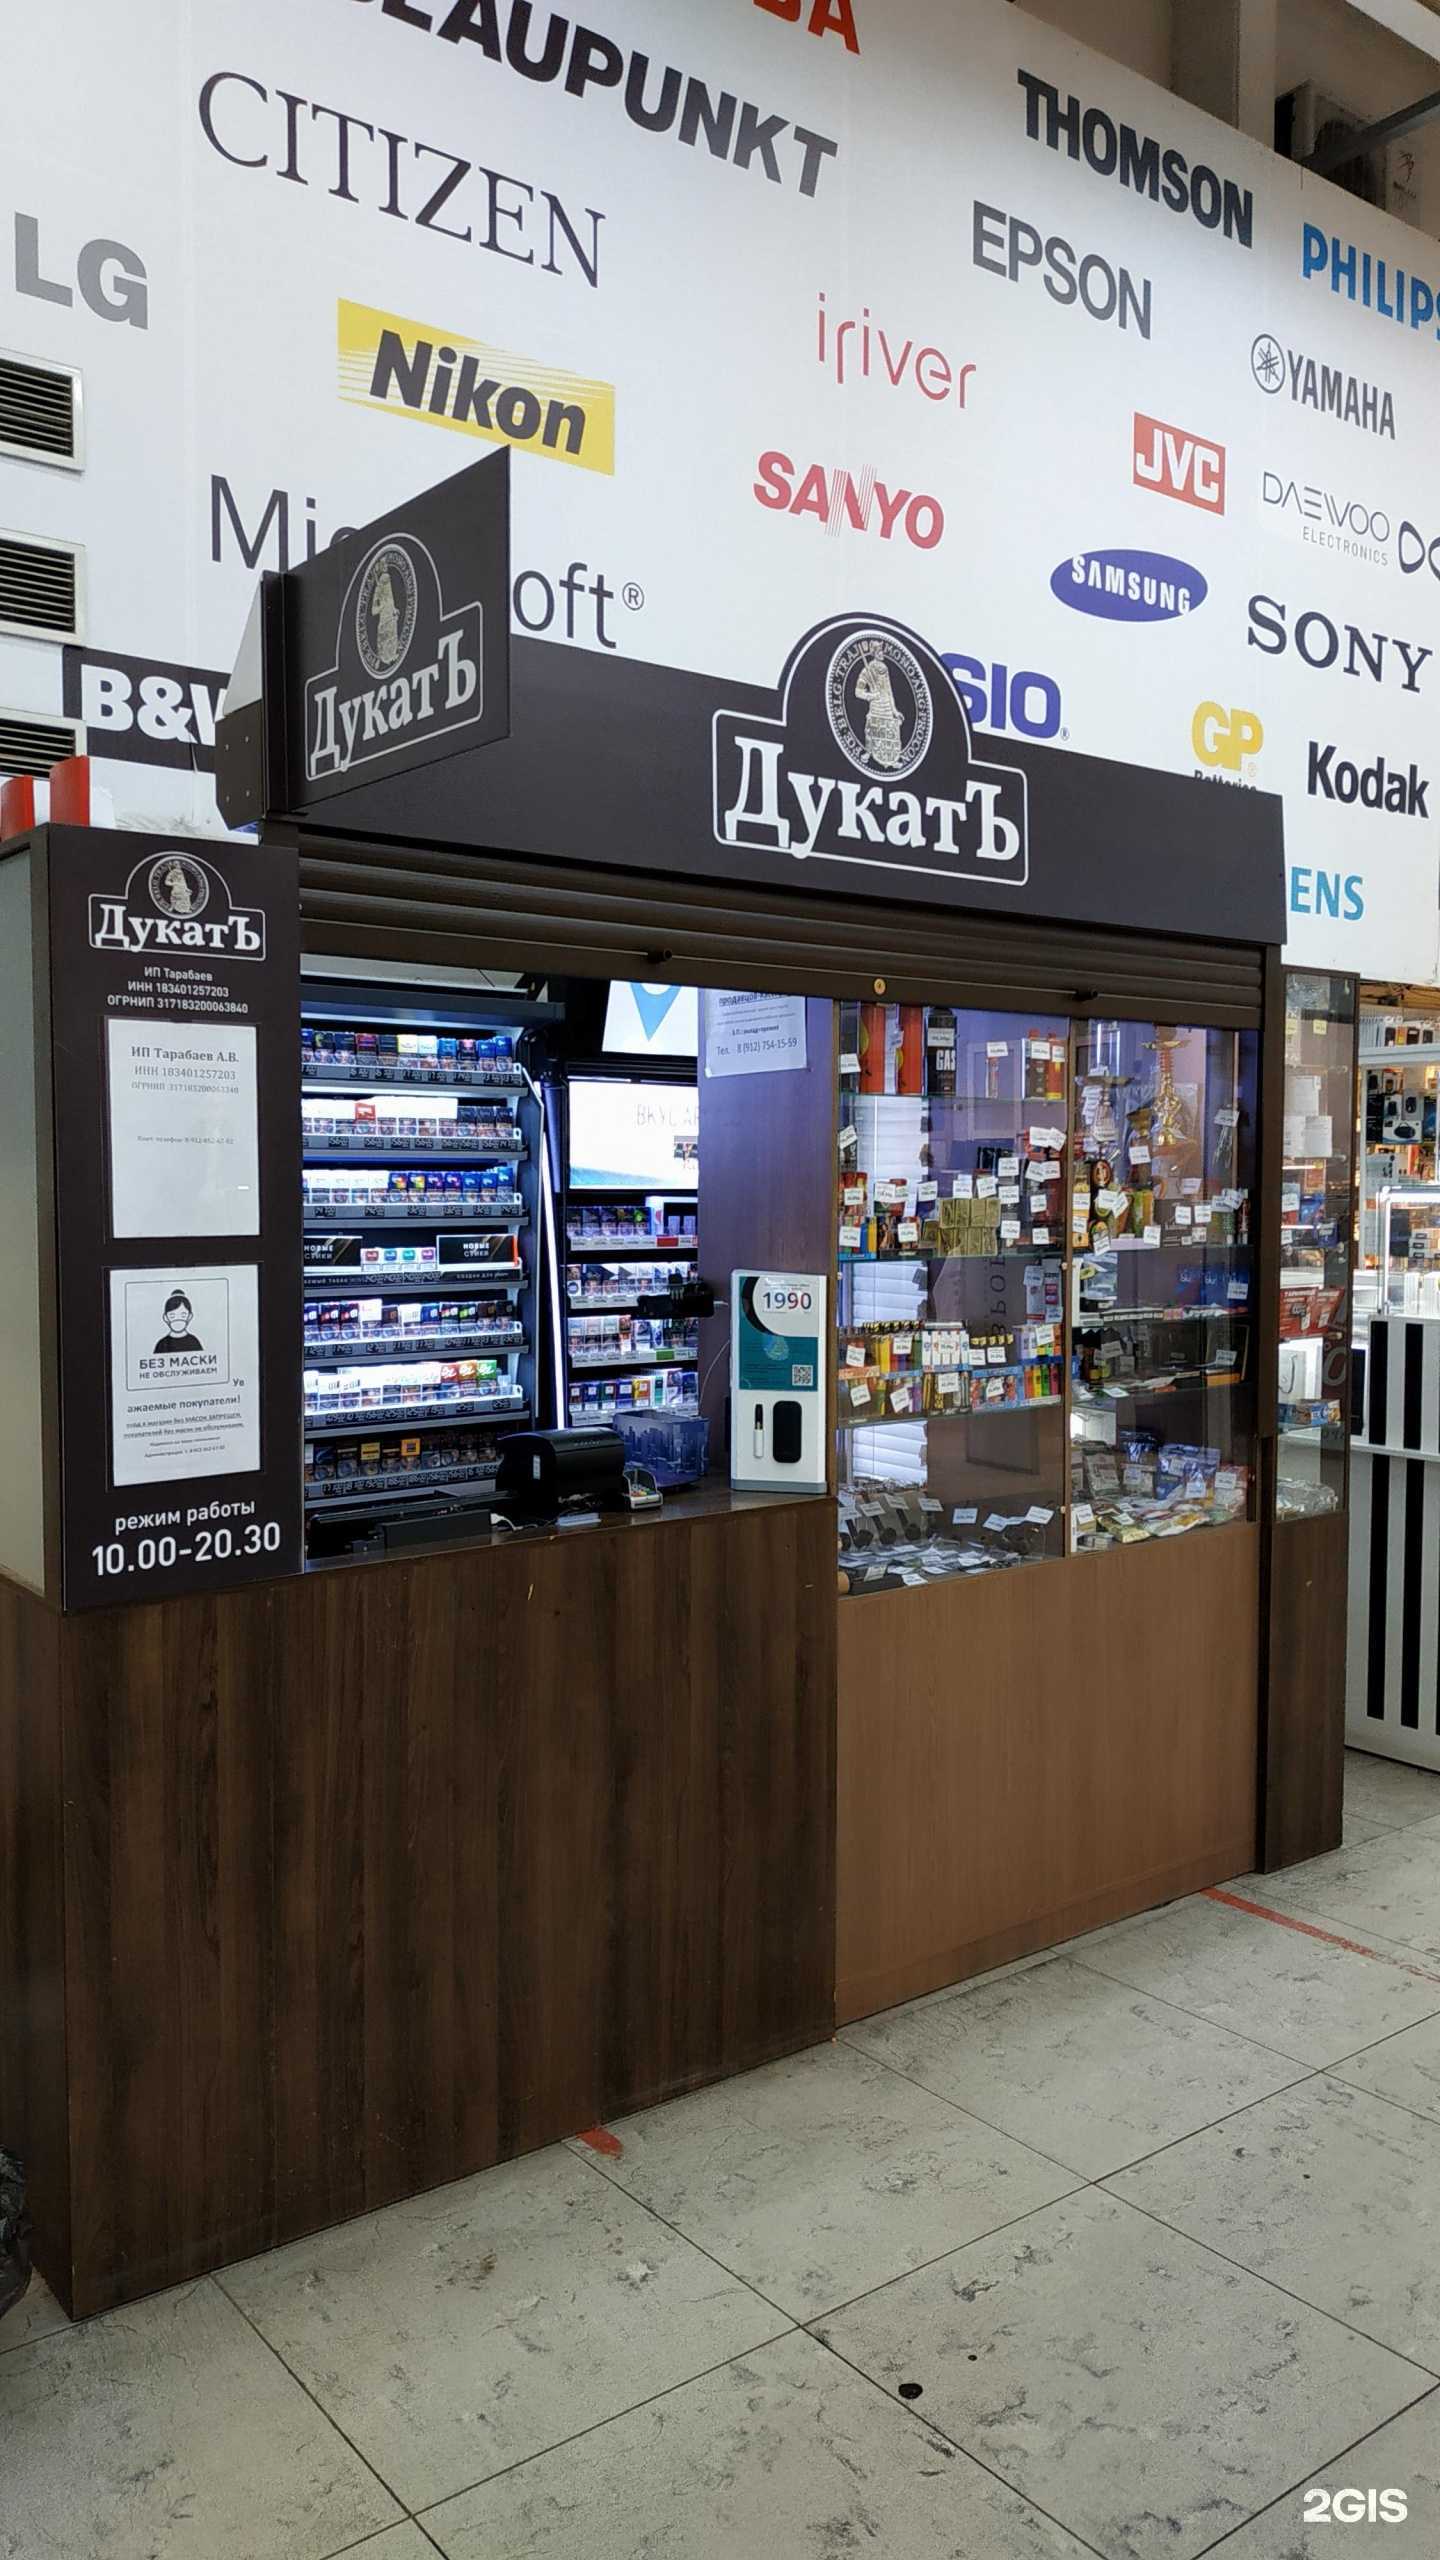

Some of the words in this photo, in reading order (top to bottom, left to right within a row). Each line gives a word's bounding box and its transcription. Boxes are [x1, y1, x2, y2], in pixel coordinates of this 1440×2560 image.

[199, 72, 606, 289] CITIZEN
[1017, 68, 1254, 249] THOMSON
[14, 211, 149, 330] LG
[973, 200, 1152, 341] EPSON
[818, 291, 977, 409] iriver
[369, 328, 587, 455] Nikon
[1287, 349, 1396, 440] YAMAHA
[753, 450, 945, 549] SANYO
[1136, 428, 1220, 503] JVC
[1263, 471, 1391, 542] DAEWOO
[1303, 526, 1389, 566] ELECTRONICS
[1071, 554, 1191, 616] SAMSUNG
[1247, 594, 1433, 693] SONY
[1192, 701, 1264, 772] GP
[1307, 740, 1430, 819] Kodak
[107, 995, 154, 1008] ОГРНИП
[127, 981, 153, 992] ИНН
[156, 982, 230, 997] 183401257203
[144, 966, 161, 978] ИП
[164, 968, 213, 982] Тарабаев
[131, 1046, 151, 1058] ИП
[154, 1047, 214, 1062] Тарабаев
[762, 1291, 812, 1310] 1990
[139, 1358, 165, 1370] БЕЗ
[169, 1354, 217, 1368] МАСКИ
[139, 1371, 151, 1379] НЕ
[152, 1367, 217, 1379] ОБСЛУЖИВАЕМ
[127, 1401, 177, 1413] ажаемые
[179, 1394, 241, 1409] покупатели!
[92, 1522, 281, 1576] 10.00-20.30
[115, 1508, 181, 1535] режим
[187, 1499, 256, 1525] работы
